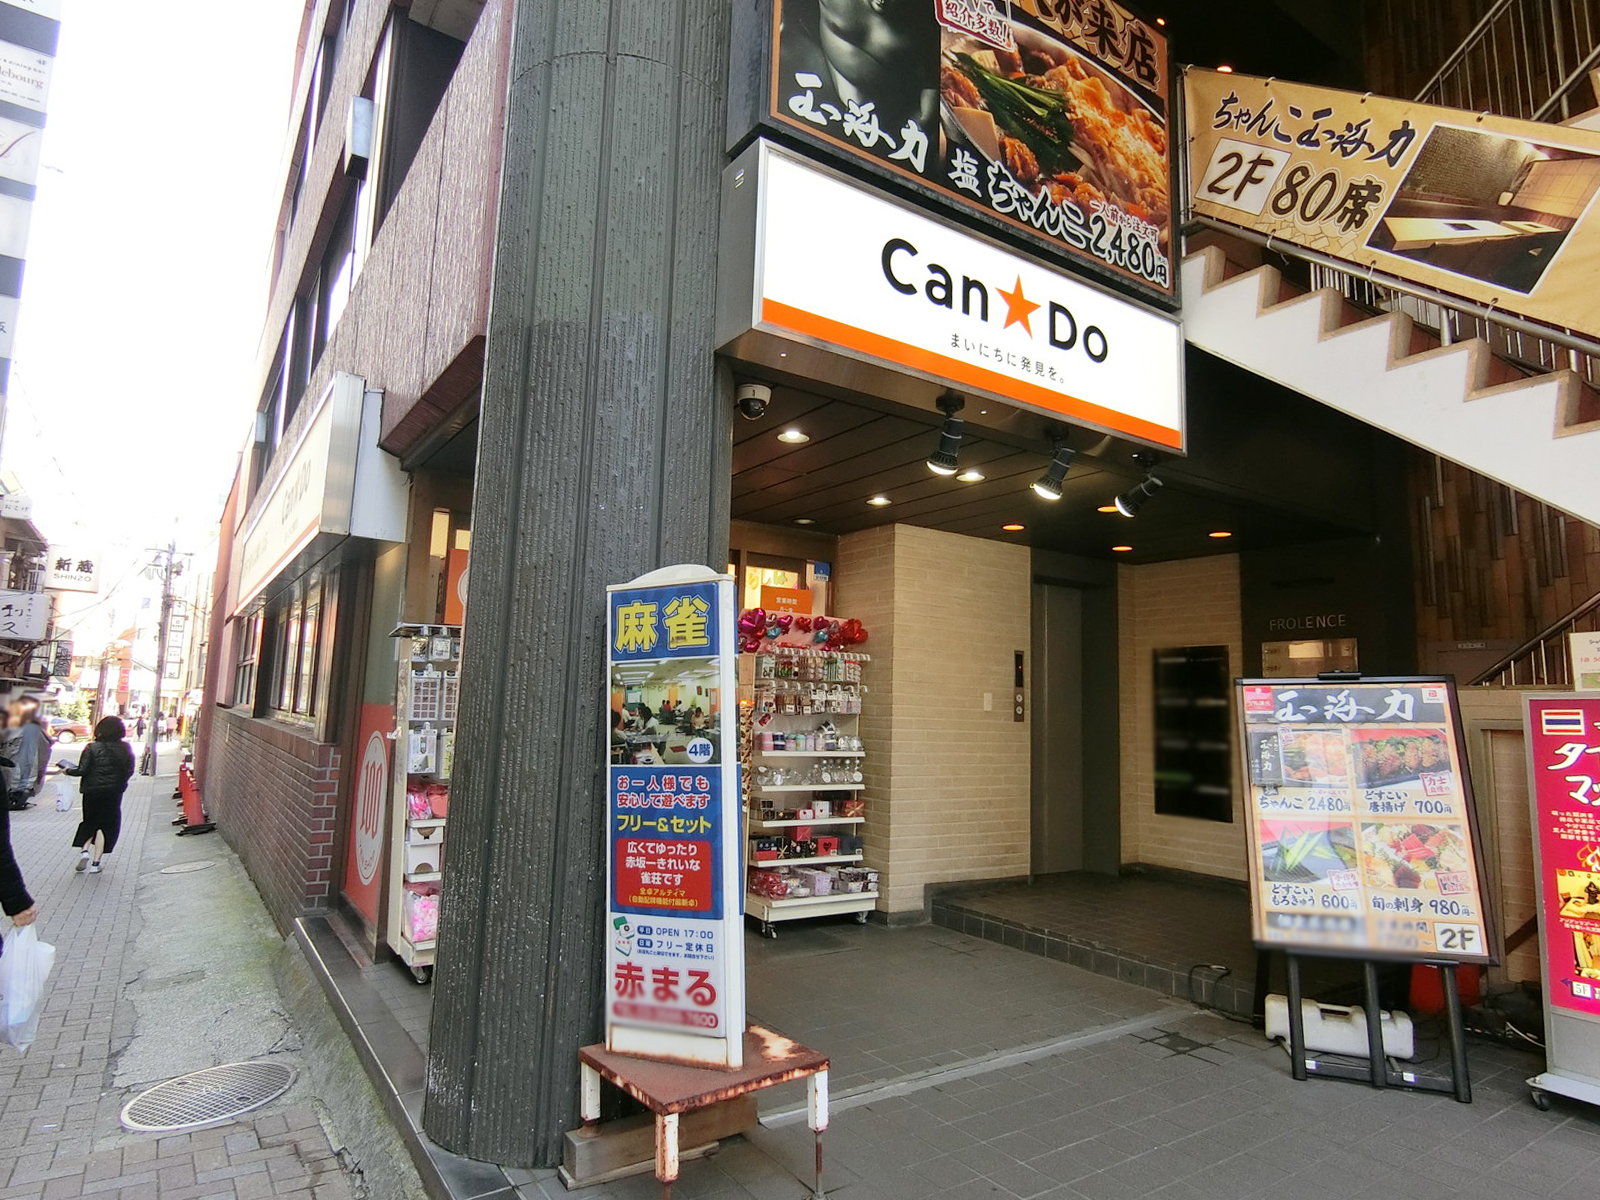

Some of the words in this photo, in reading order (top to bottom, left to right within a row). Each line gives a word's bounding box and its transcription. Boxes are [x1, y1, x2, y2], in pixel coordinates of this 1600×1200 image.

[1207, 151, 1274, 201] 2F
[1271, 163, 1383, 233] 80席
[881, 238, 990, 323] Can
[1049, 301, 1108, 364] Do
[950, 332, 1066, 385] まいにちに発見を。
[55, 557, 94, 574] 新蔵
[53, 573, 92, 583] SHINZO
[614, 595, 710, 653] 麻雀
[1270, 614, 1347, 631] FROLENCE
[688, 743, 711, 757] 4階
[617, 775, 710, 791] お一人様でも
[360, 760, 383, 840] 100
[617, 793, 710, 809] 安心して遊べます
[1259, 795, 1303, 809] ちゃんこ
[1364, 790, 1408, 800] どすこい
[1368, 800, 1406, 813] 唐揚げ
[1414, 800, 1452, 814] 700円
[617, 815, 712, 834] フリー&セット
[627, 841, 698, 856] 広くてゆったり
[625, 856, 701, 872] 赤坂一きれいな
[640, 872, 684, 886] 雀荘です
[1271, 884, 1314, 895] どすこい
[1372, 895, 1423, 913] 旬の刺身
[655, 927, 680, 937] OPEN
[684, 929, 714, 939] 17:00
[1439, 928, 1475, 951] 2F
[656, 940, 714, 953] フリー定休日
[614, 961, 717, 1007] 赤まる
[1575, 983, 1588, 995] 5F
